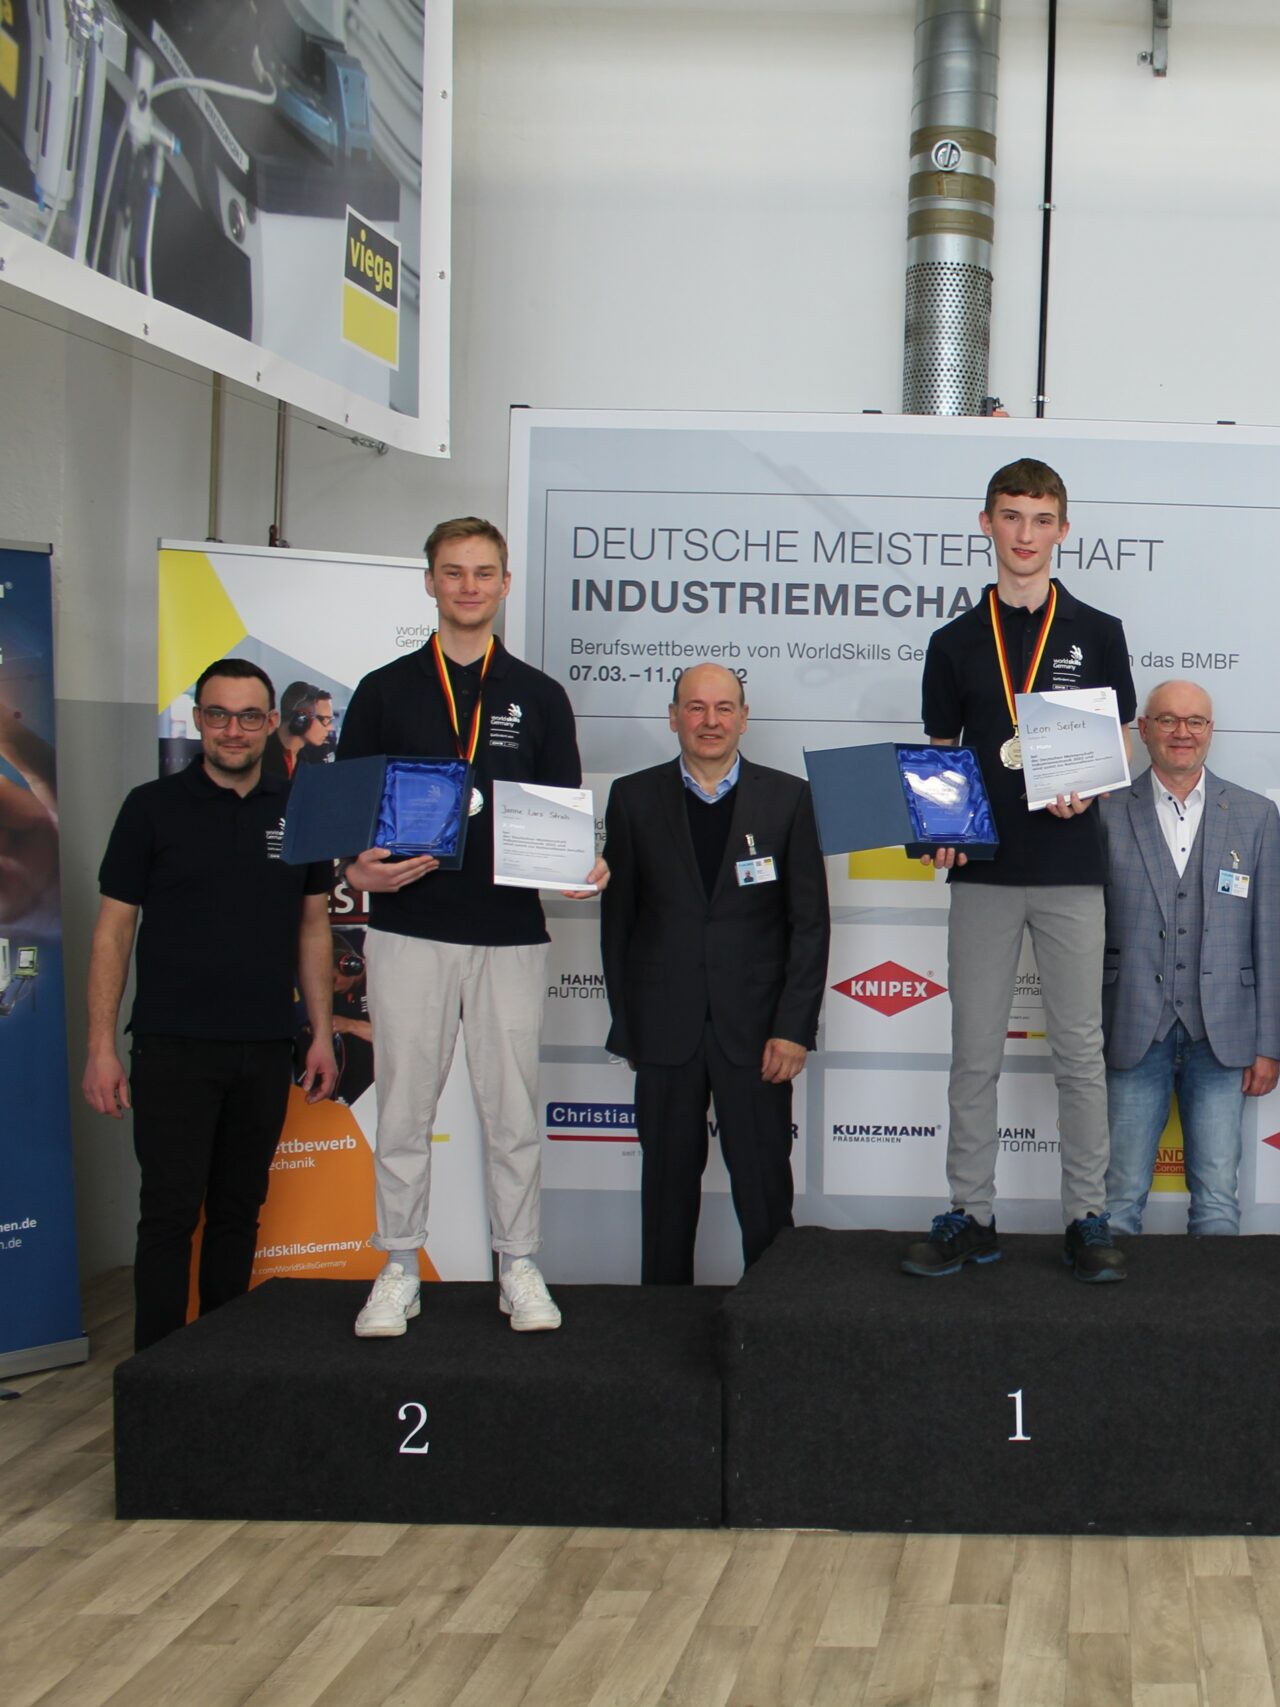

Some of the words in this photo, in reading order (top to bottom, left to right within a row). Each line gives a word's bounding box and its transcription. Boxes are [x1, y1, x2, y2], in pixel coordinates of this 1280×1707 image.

[350, 229, 393, 292] viega
[572, 526, 799, 562] DEUTSCHE
[813, 531, 1164, 571] MEISTERHAFT
[571, 579, 986, 618] INDUSTRIEMECHA
[570, 638, 741, 658] Berufswettbewerb
[747, 645, 780, 658] von
[787, 642, 891, 661] WorldSkills
[1140, 651, 1175, 668] das
[1181, 652, 1240, 670] BMBF
[1026, 724, 1051, 735] Leon
[1056, 720, 1087, 732] Seifert
[561, 974, 604, 986] HAHN
[851, 980, 928, 997] KNIPEX
[548, 986, 606, 999] AUTOM
[833, 1124, 936, 1137] KUNZMANN
[833, 1136, 902, 1144] FRÄSMASCHINEN
[1001, 1140, 1061, 1152] TOMATI
[1007, 1389, 1031, 1440] 1
[398, 1402, 429, 1454] 2
